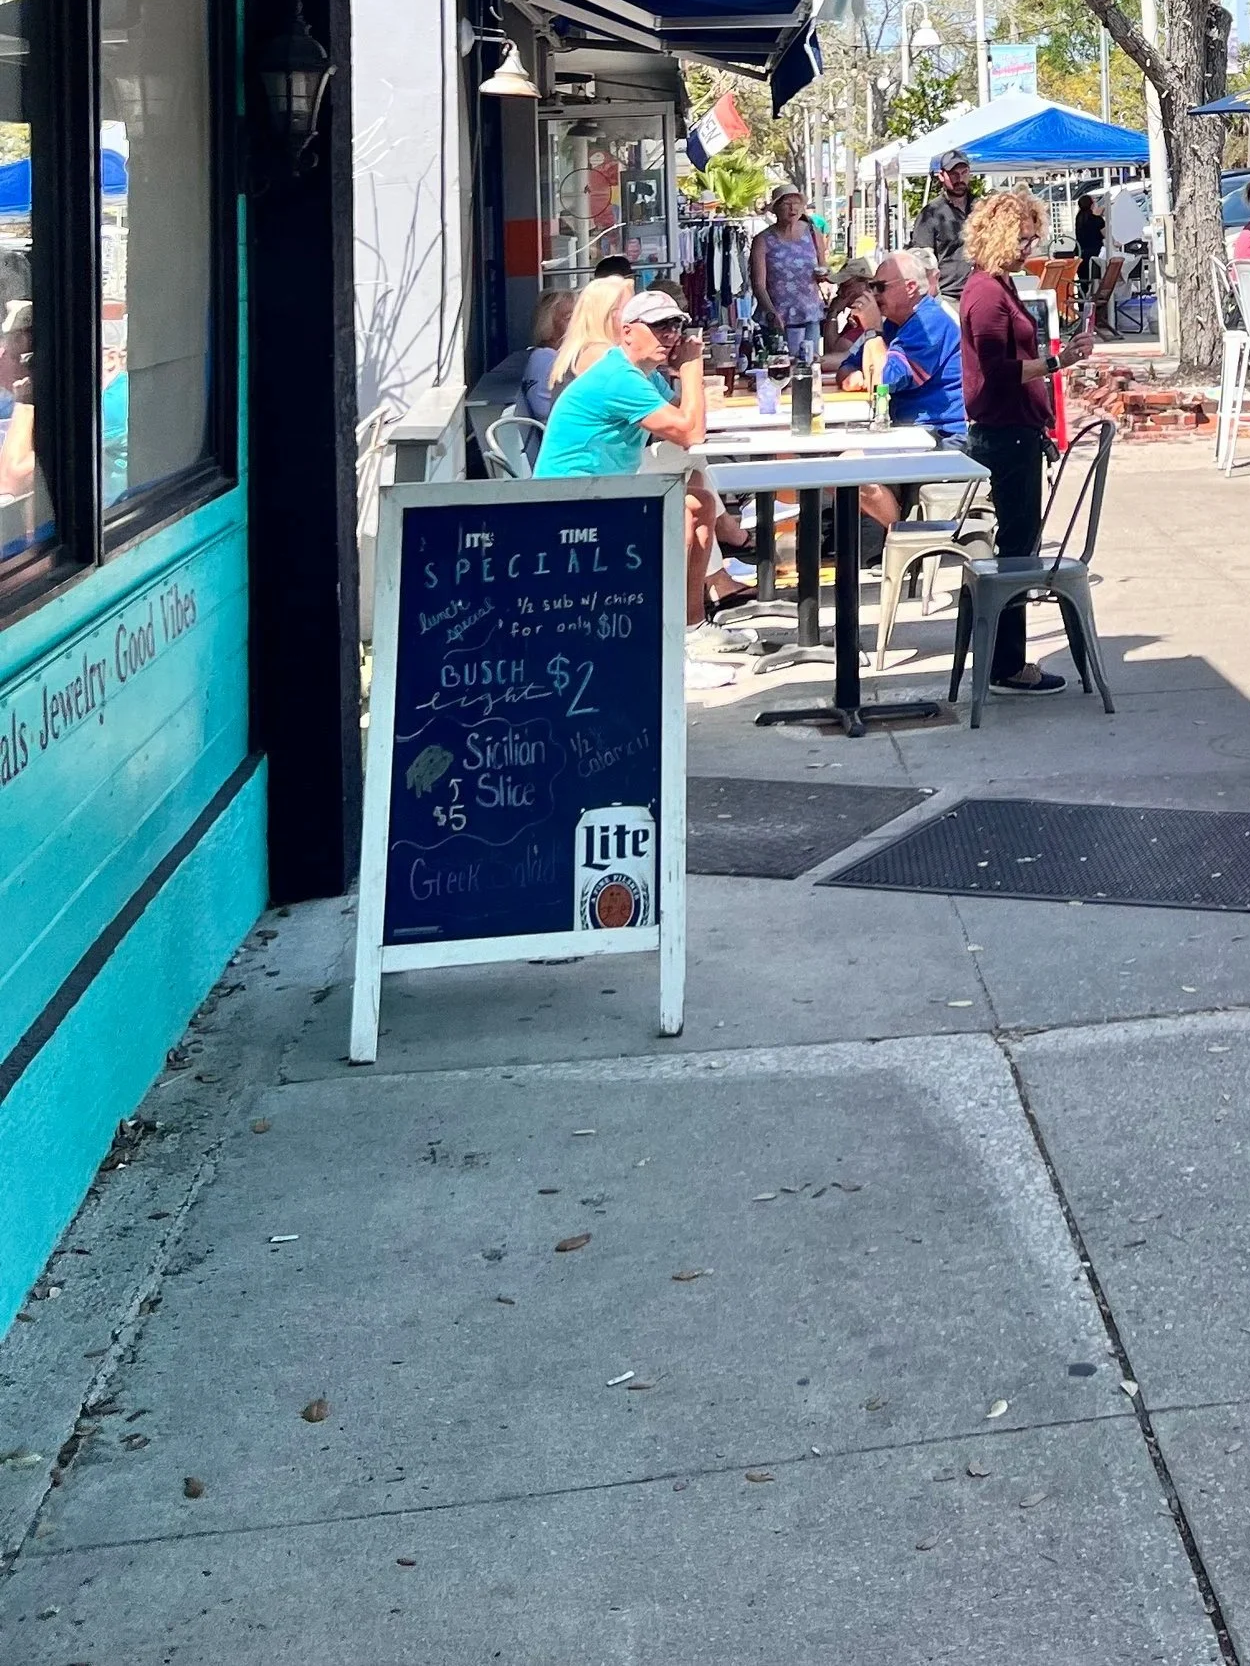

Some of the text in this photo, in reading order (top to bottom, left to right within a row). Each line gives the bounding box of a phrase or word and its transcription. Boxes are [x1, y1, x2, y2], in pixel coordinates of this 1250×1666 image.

[560, 527, 599, 545] TIME
[424, 544, 642, 589] SPECIALS
[543, 594, 574, 612] sub
[604, 592, 644, 607] chips
[508, 611, 633, 641] for only $10
[40, 652, 107, 750] Jewelry
[115, 602, 156, 683] Good
[160, 581, 197, 644] Vibes
[441, 652, 600, 718] BUSCH $2
[463, 727, 546, 771] Sicilian
[475, 773, 536, 808] Slice
[433, 804, 467, 832] $5
[582, 824, 649, 872] Lite
